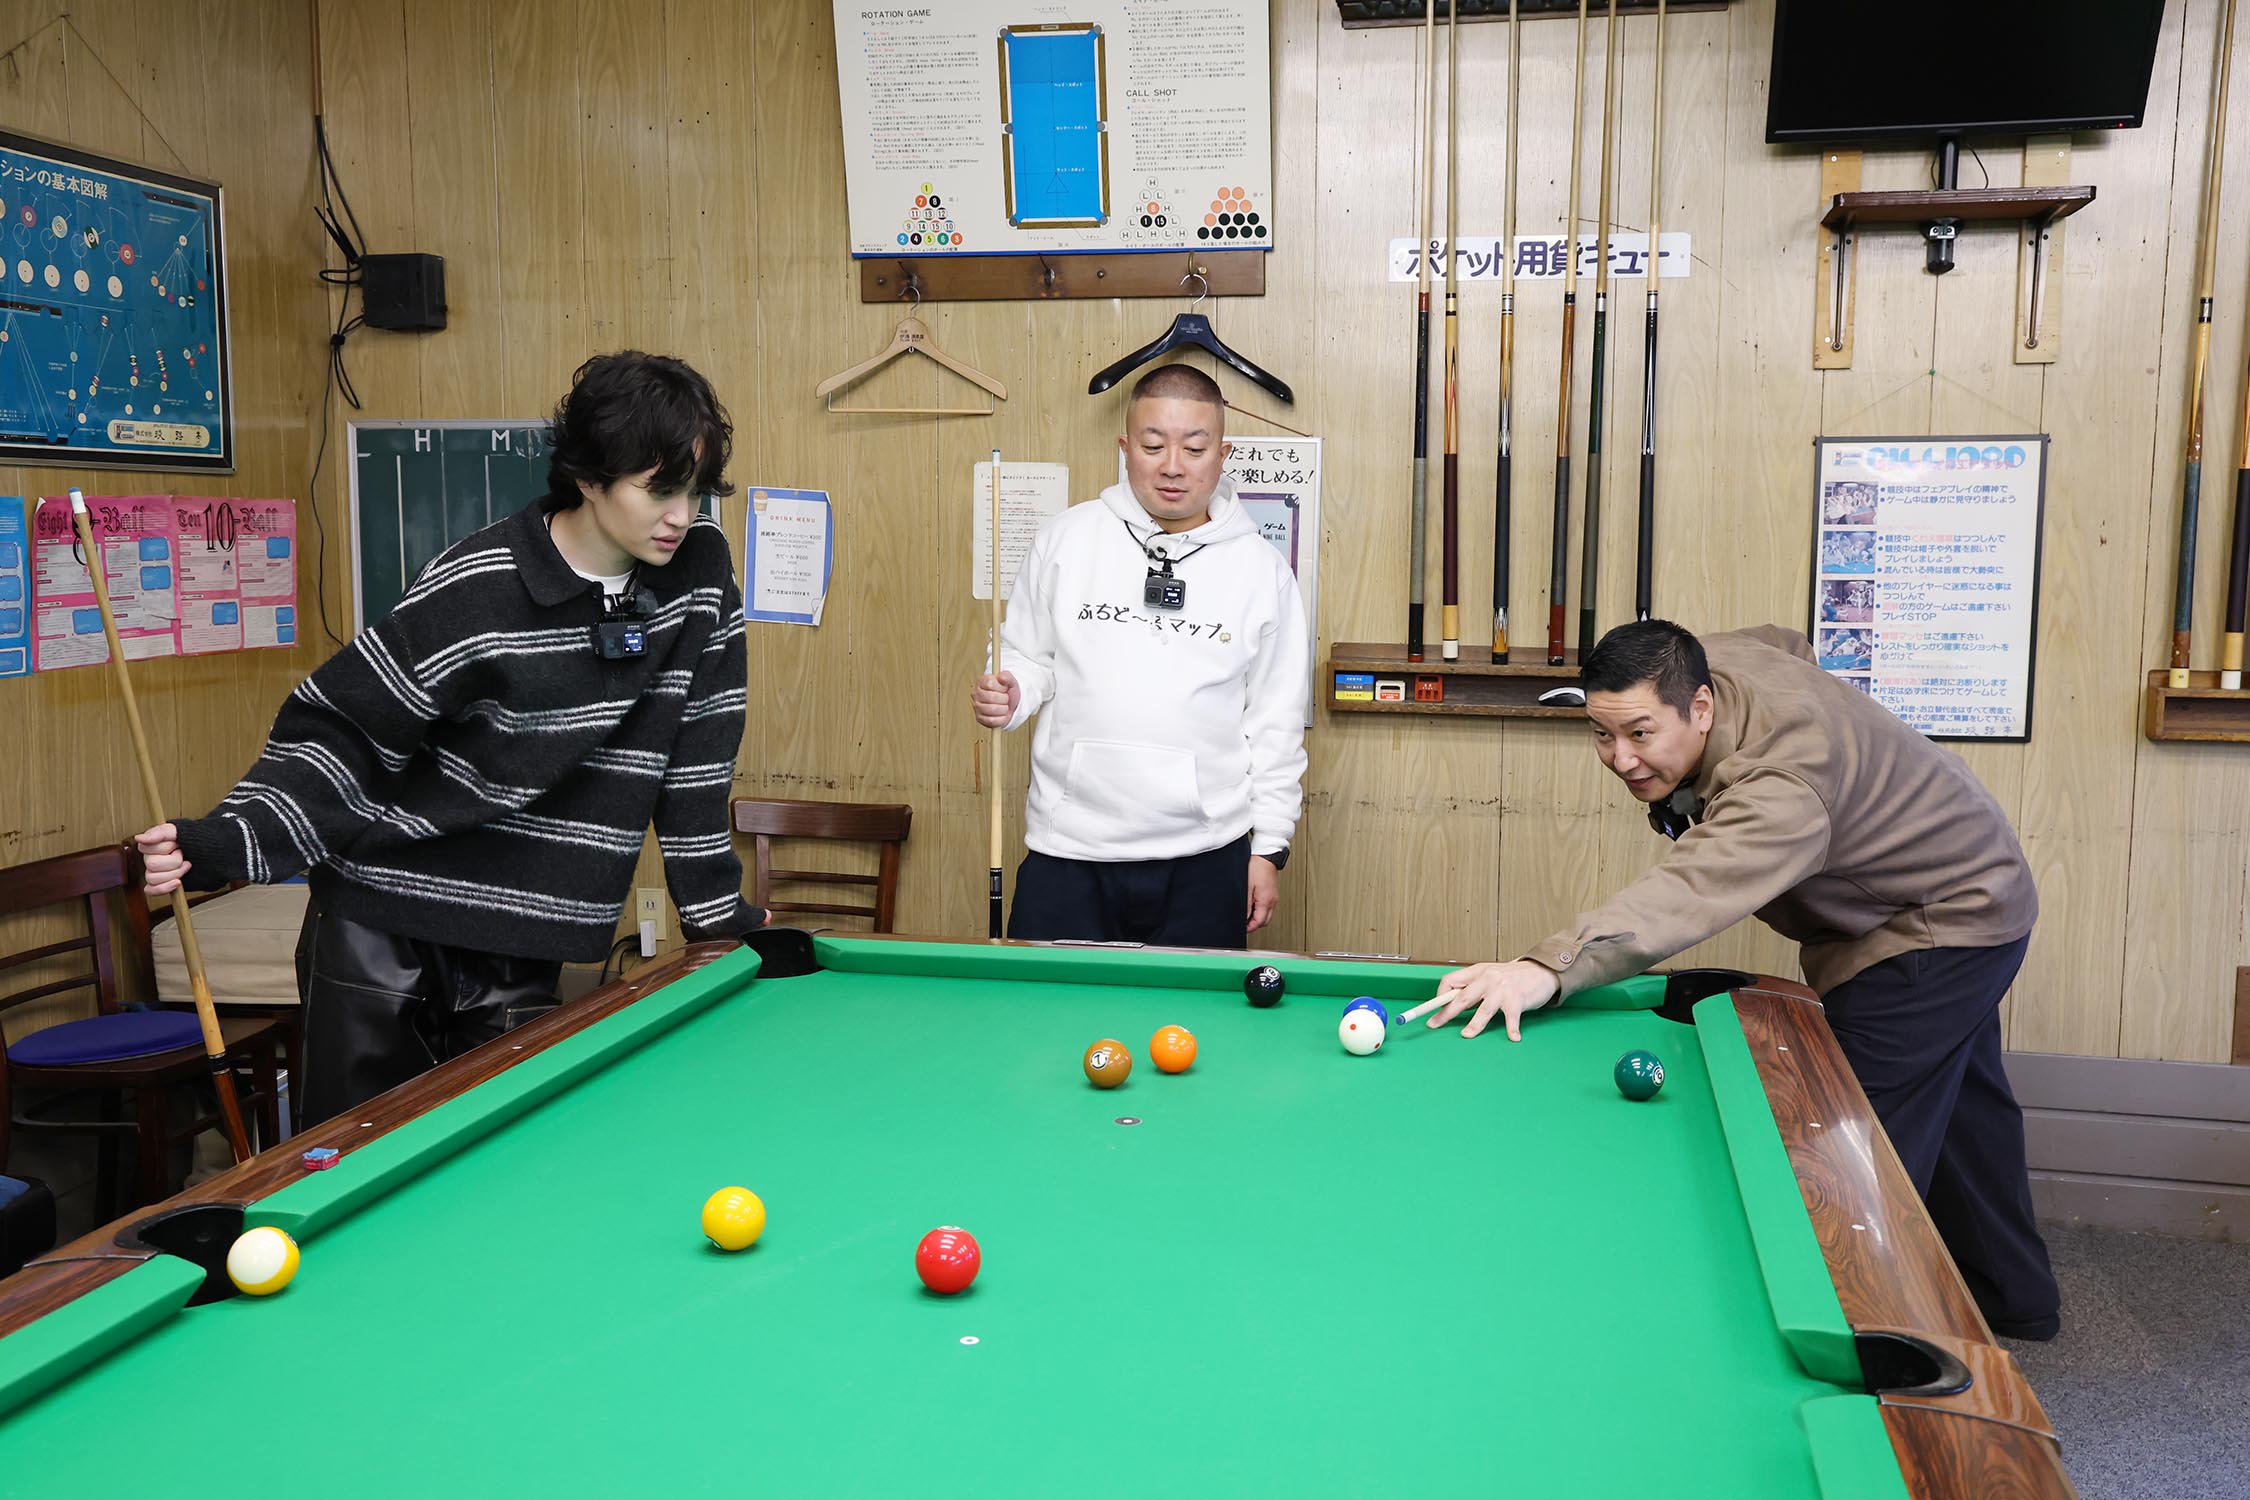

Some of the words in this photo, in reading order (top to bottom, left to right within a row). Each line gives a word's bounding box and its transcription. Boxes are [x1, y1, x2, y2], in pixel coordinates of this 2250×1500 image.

[861, 10, 904, 19] ROTATION
[907, 9, 932, 17] GAME
[1126, 89, 1149, 97] CALL
[1153, 89, 1178, 97] SHOT
[0, 159, 109, 200] ションの基本図解
[1406, 240, 1670, 277] ポケット用貸キュー
[414, 429, 431, 452] H
[491, 429, 511, 451] M
[1228, 446, 1300, 464] だれでも
[1223, 468, 1314, 484] ぐ楽しめる!
[1885, 555, 1953, 563] プレイしましょう
[1882, 592, 1926, 601] つつしんで
[1882, 612, 1937, 621] プレイSTOP
[1879, 696, 1905, 704] 下さい
